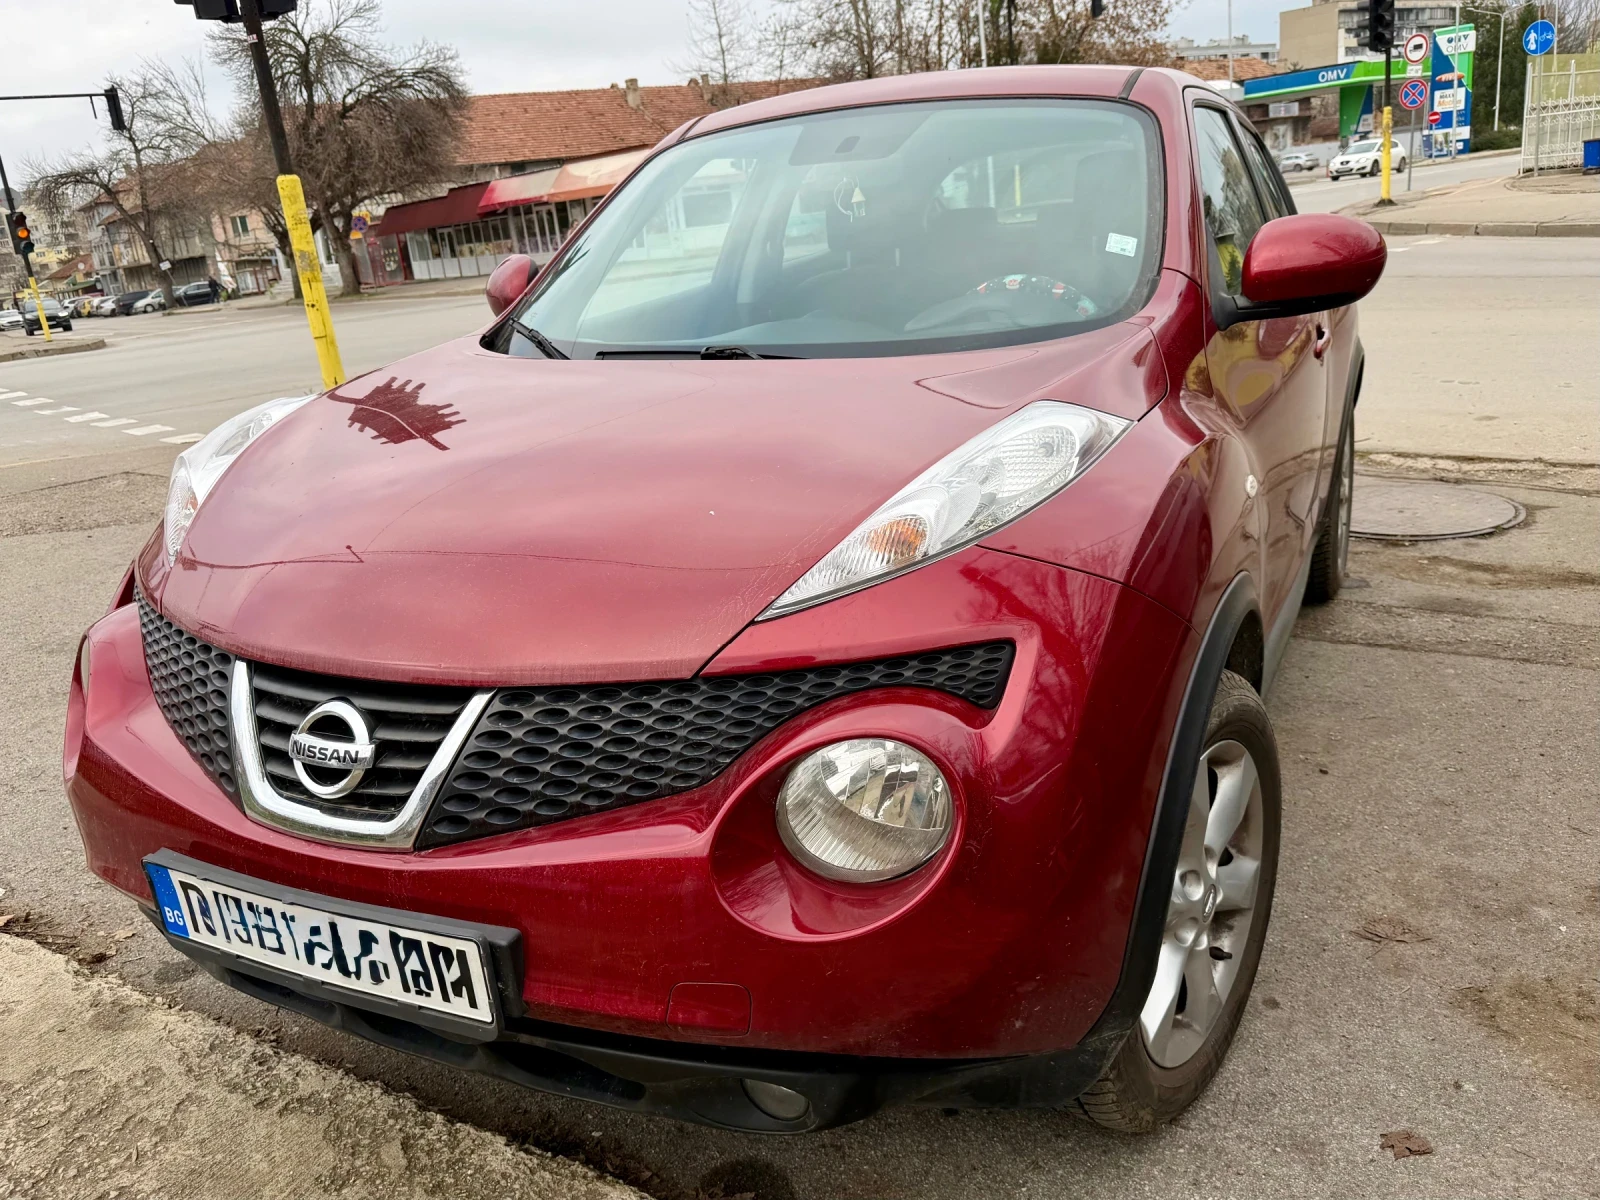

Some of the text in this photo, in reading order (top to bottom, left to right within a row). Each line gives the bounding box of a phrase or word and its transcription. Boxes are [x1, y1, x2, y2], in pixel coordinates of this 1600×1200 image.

[1446, 44, 1468, 53] OMV
[1318, 68, 1347, 82] OMV
[292, 740, 359, 764] NISSAN
[164, 906, 184, 926] BG
